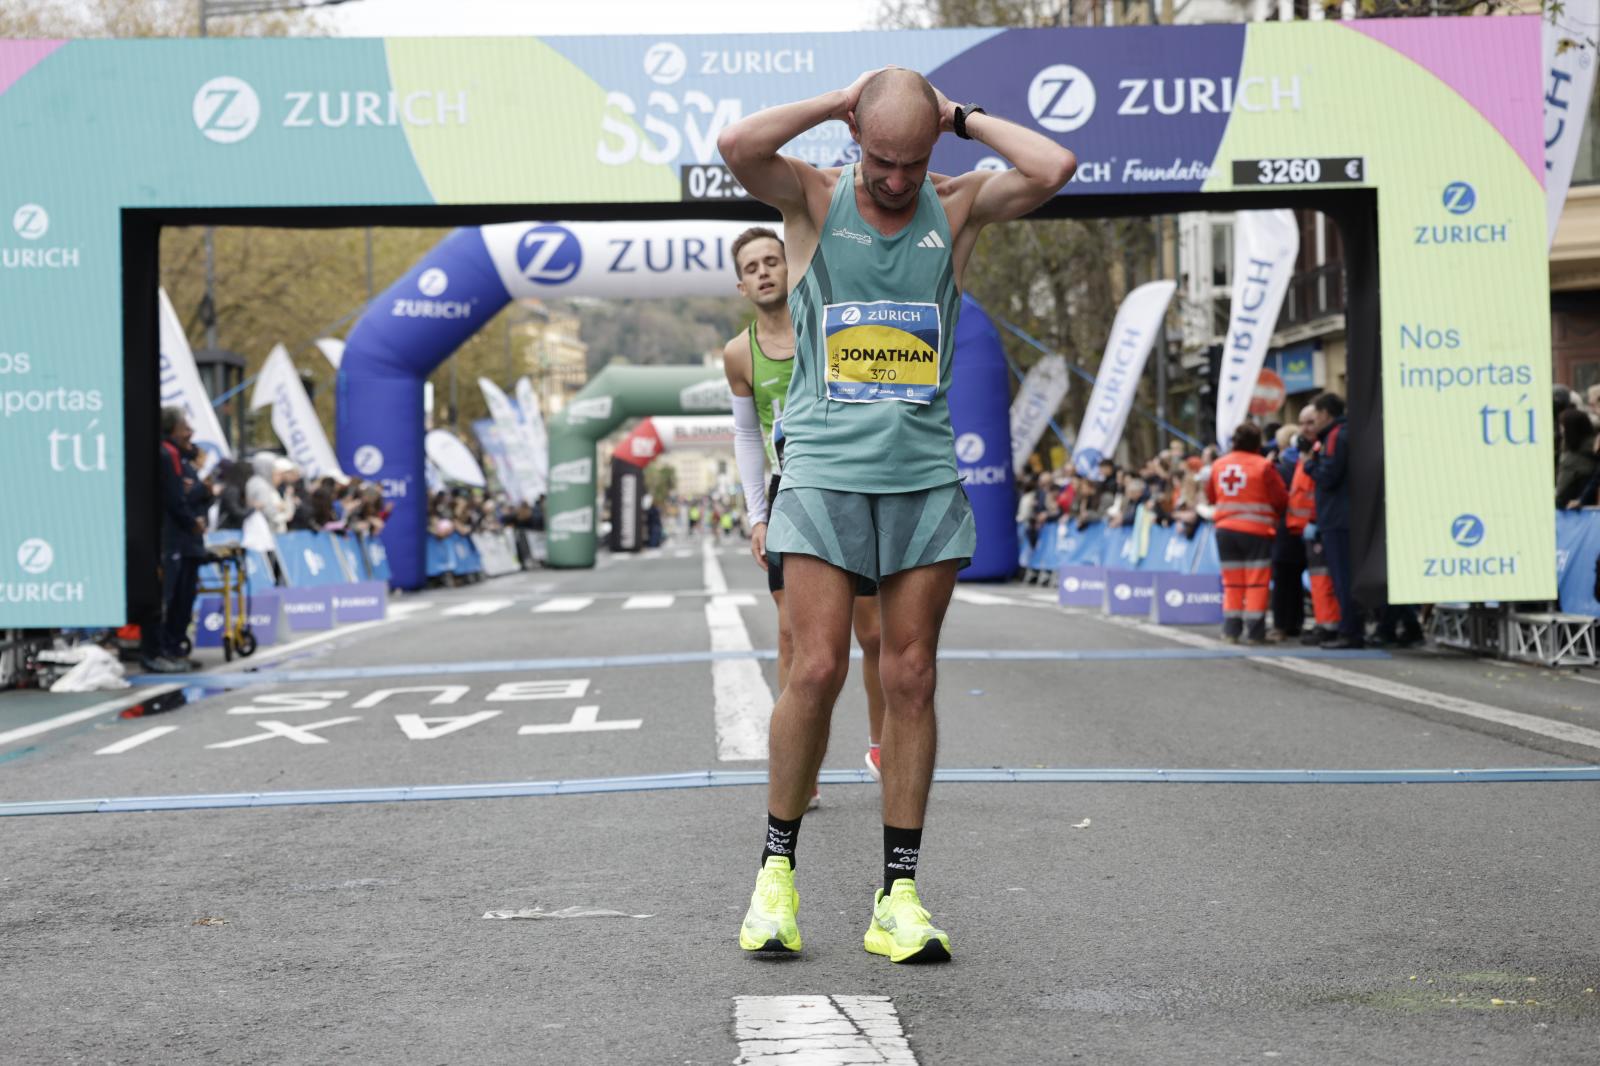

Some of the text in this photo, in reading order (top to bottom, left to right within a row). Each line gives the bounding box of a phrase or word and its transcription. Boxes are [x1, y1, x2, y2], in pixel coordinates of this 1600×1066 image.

[700, 49, 814, 75] ZURICH
[1117, 75, 1302, 116] ZURICH
[283, 92, 468, 127] ZURICH
[1121, 158, 1222, 184] Foundation
[1258, 159, 1360, 183] 3260 €
[1414, 224, 1507, 244] ZURICH
[0, 247, 80, 268] URICH
[607, 238, 725, 274] ZURI
[392, 299, 471, 319] ZURICH
[867, 310, 921, 322] ZURICH
[1400, 323, 1460, 350] Nos
[0, 351, 31, 374] os
[840, 348, 934, 363] JONATHAN
[870, 368, 897, 381] 370
[1093, 328, 1142, 434] ZURICH
[1400, 363, 1532, 391] importas
[0, 386, 104, 418] portas
[1479, 393, 1537, 446] tú
[48, 418, 107, 472] tú
[1423, 556, 1515, 577] ZURICH
